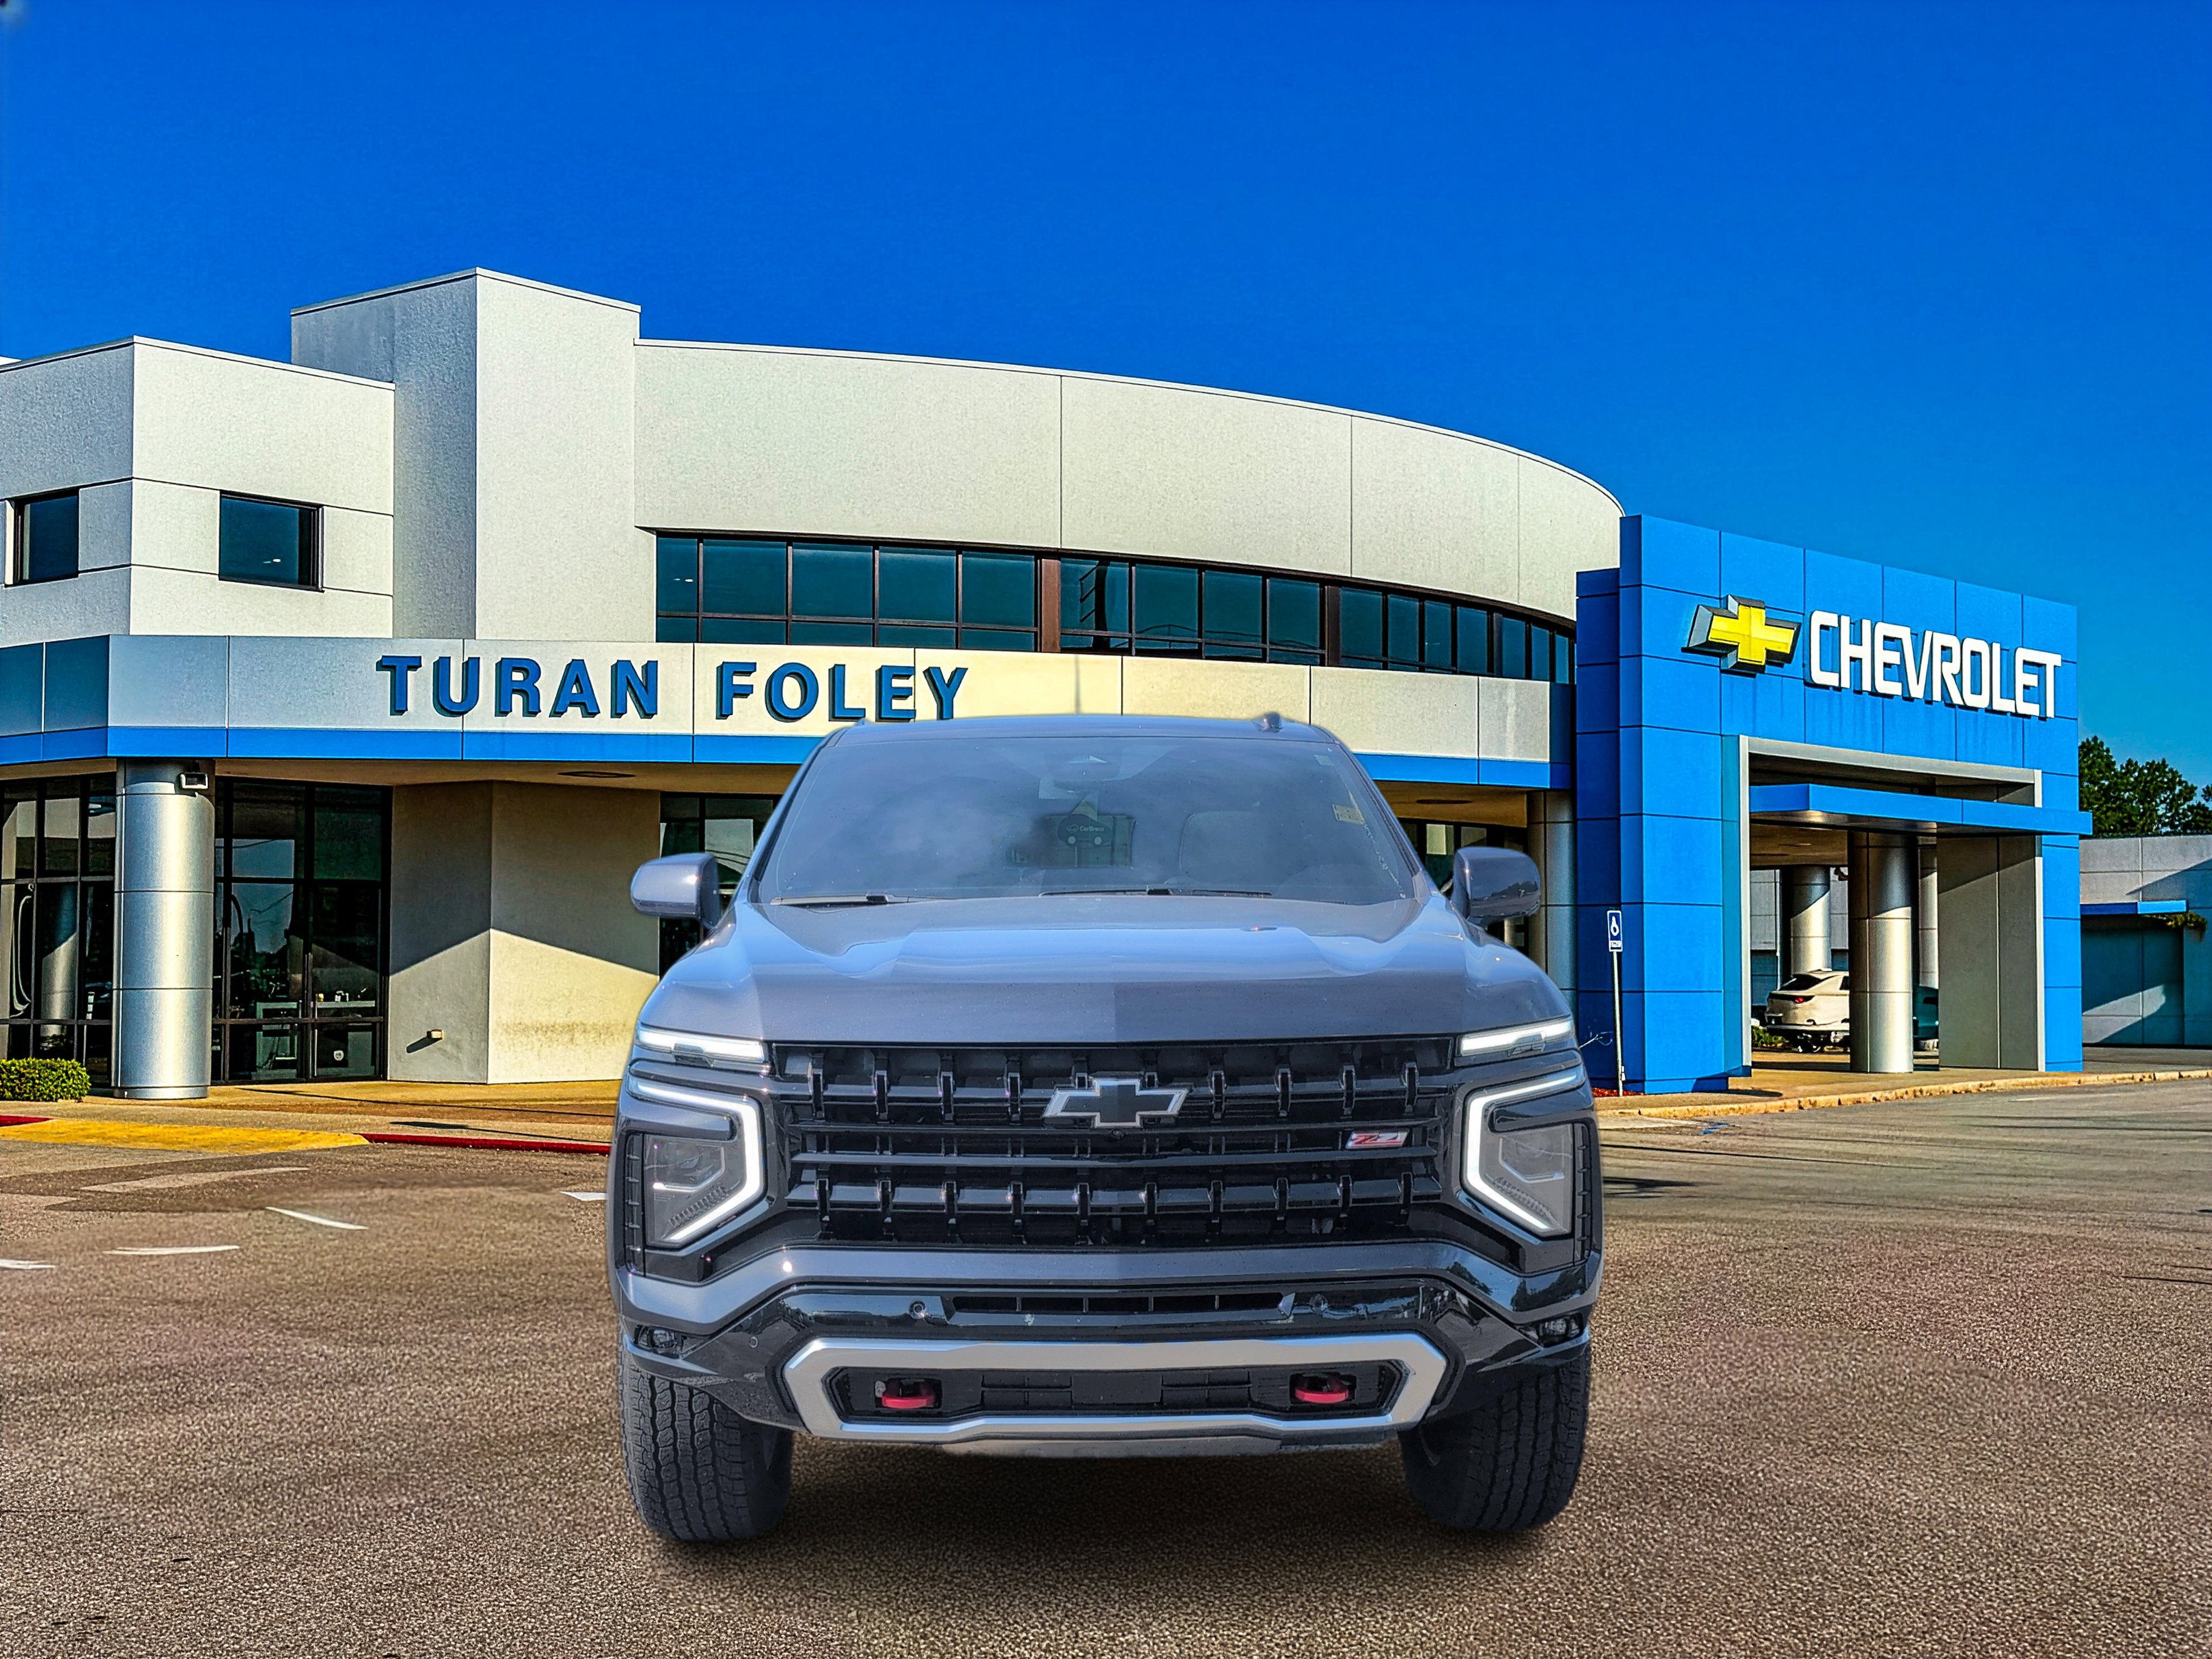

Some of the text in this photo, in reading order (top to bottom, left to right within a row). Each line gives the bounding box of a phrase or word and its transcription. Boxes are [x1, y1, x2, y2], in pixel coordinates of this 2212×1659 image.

[377, 655, 969, 722] TURAN FOLEY
[1810, 610, 2062, 718] CHEVROLET
